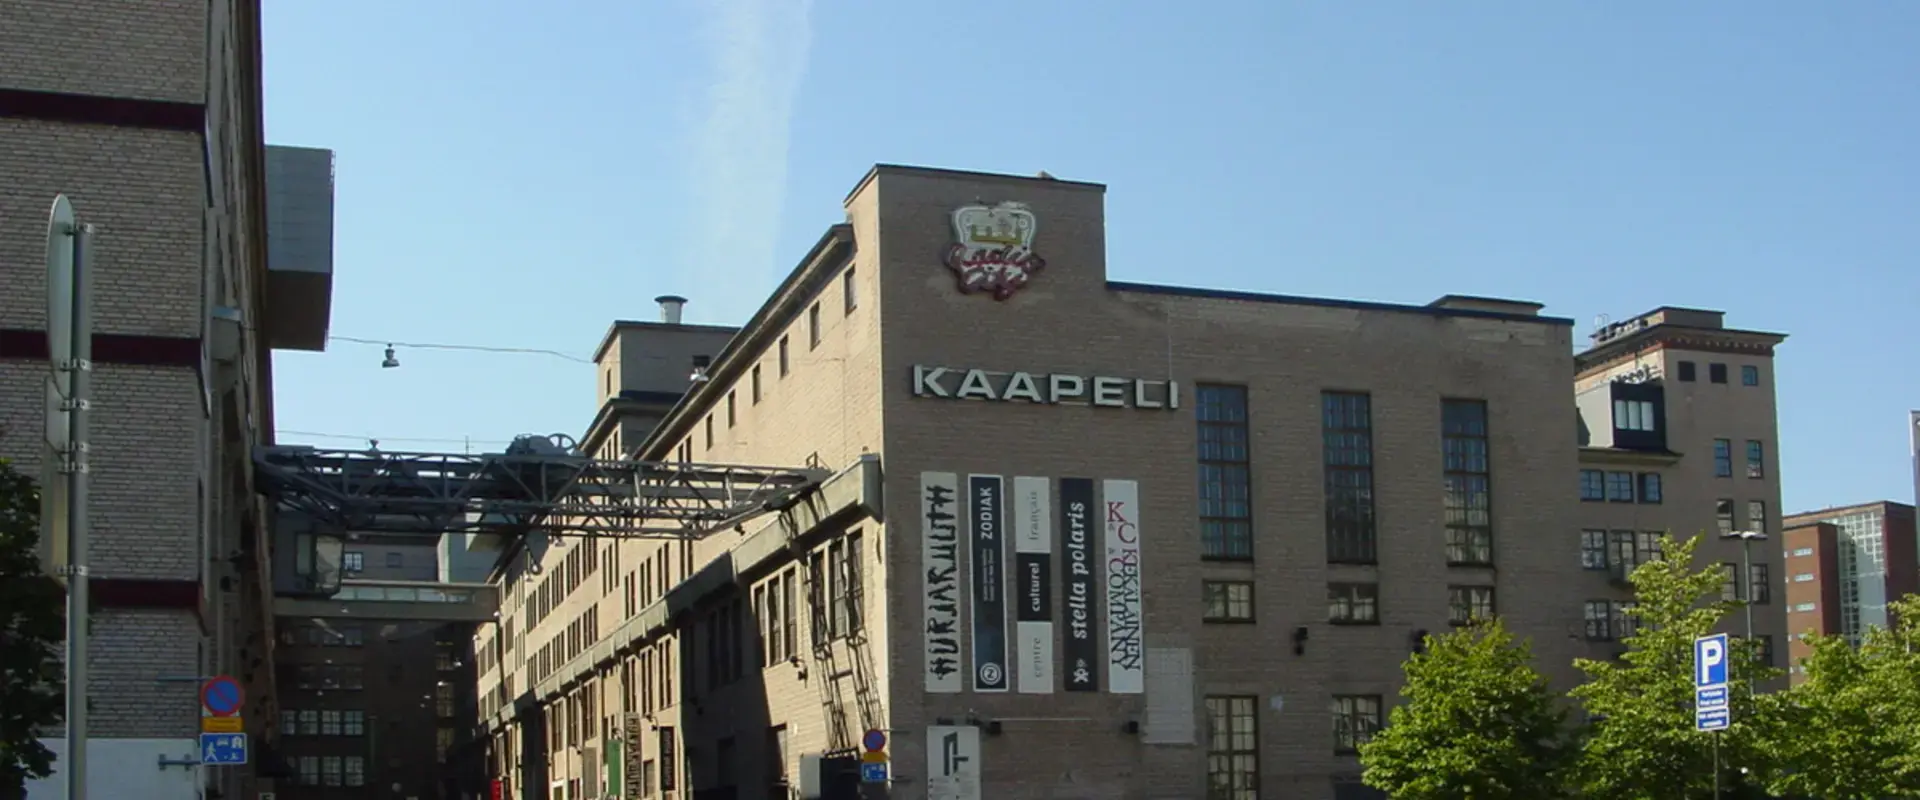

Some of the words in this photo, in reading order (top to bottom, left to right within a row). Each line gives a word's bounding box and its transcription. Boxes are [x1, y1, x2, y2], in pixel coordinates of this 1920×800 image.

[912, 364, 1178, 409] KAAPELI
[980, 487, 993, 540] ZODIAK
[1028, 490, 1040, 540] français
[1107, 501, 1126, 523] K
[1118, 522, 1137, 544] C
[1067, 501, 1088, 576] polaris
[926, 484, 959, 680] HURJARUUTH
[1029, 562, 1041, 612] culturel
[1068, 582, 1087, 639] stella
[1108, 558, 1129, 672] COMPANY
[1033, 637, 1042, 679] centre
[1701, 640, 1723, 684] P
